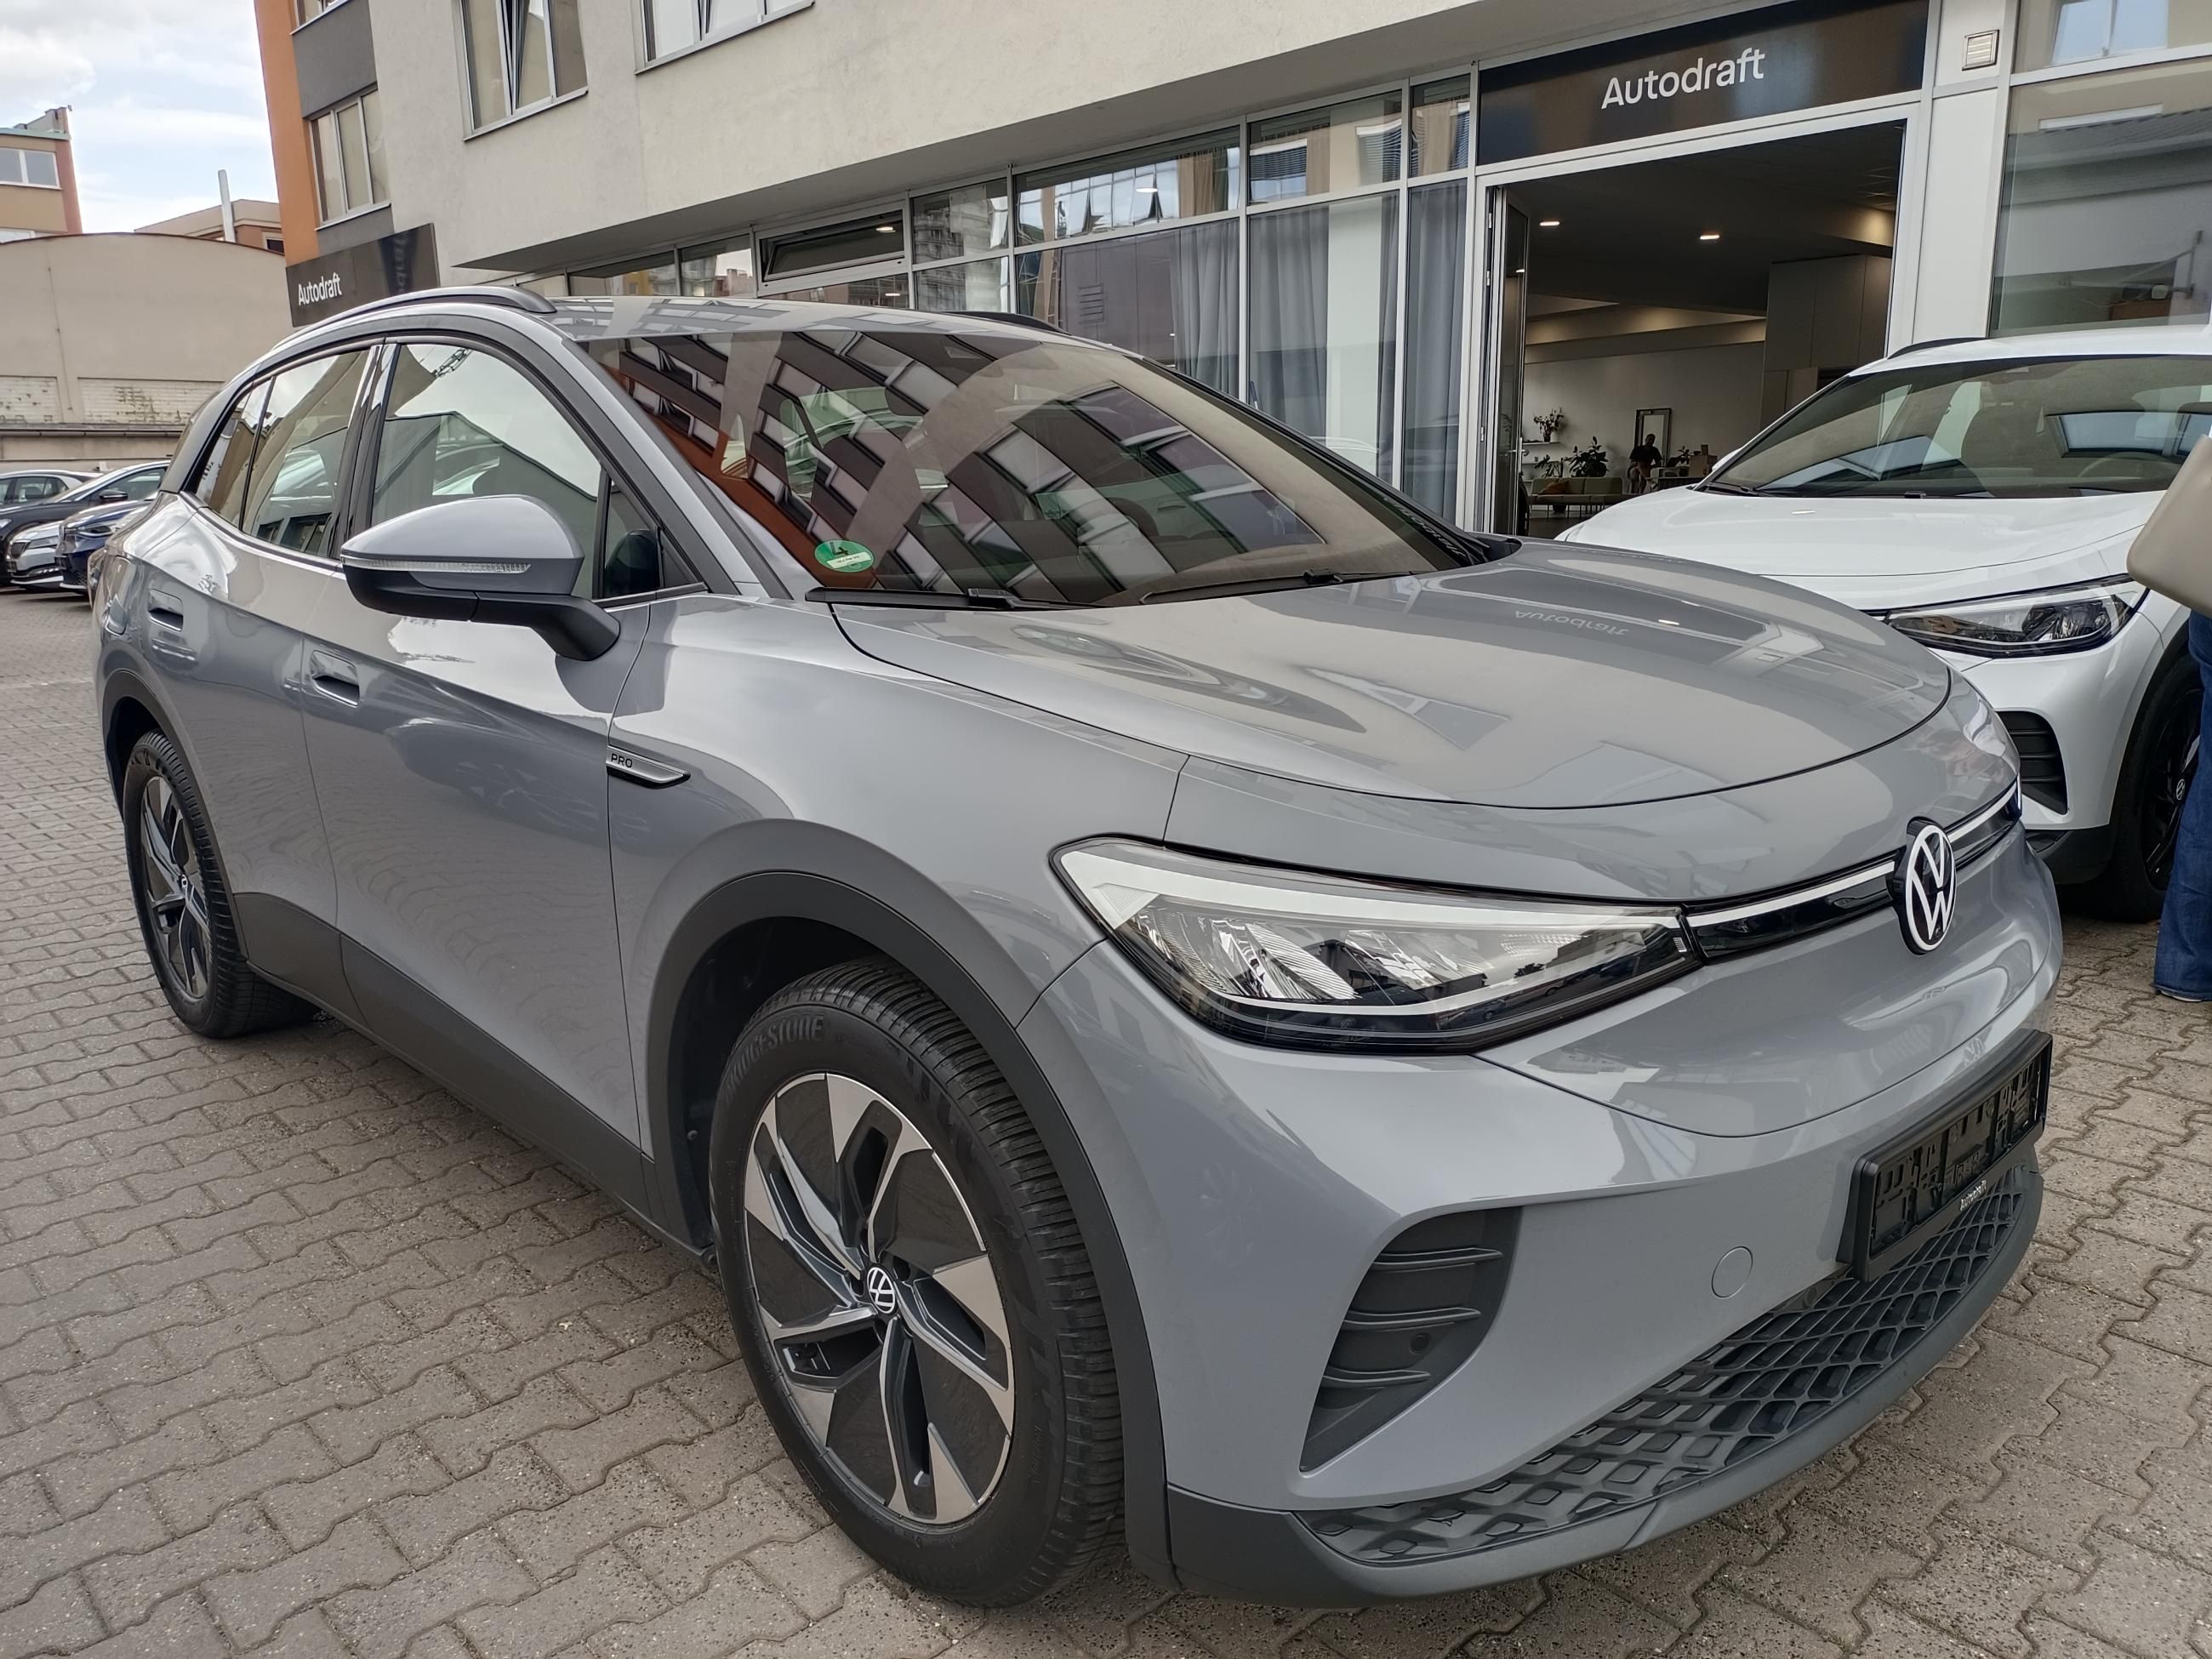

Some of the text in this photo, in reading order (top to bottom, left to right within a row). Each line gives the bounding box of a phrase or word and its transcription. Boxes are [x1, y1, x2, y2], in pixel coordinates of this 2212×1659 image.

[1600, 47, 1765, 110] Autodraft
[298, 271, 343, 306] Autodraft
[611, 753, 633, 768] PRO
[1906, 824, 1956, 951] VW
[866, 1267, 896, 1314] VW
